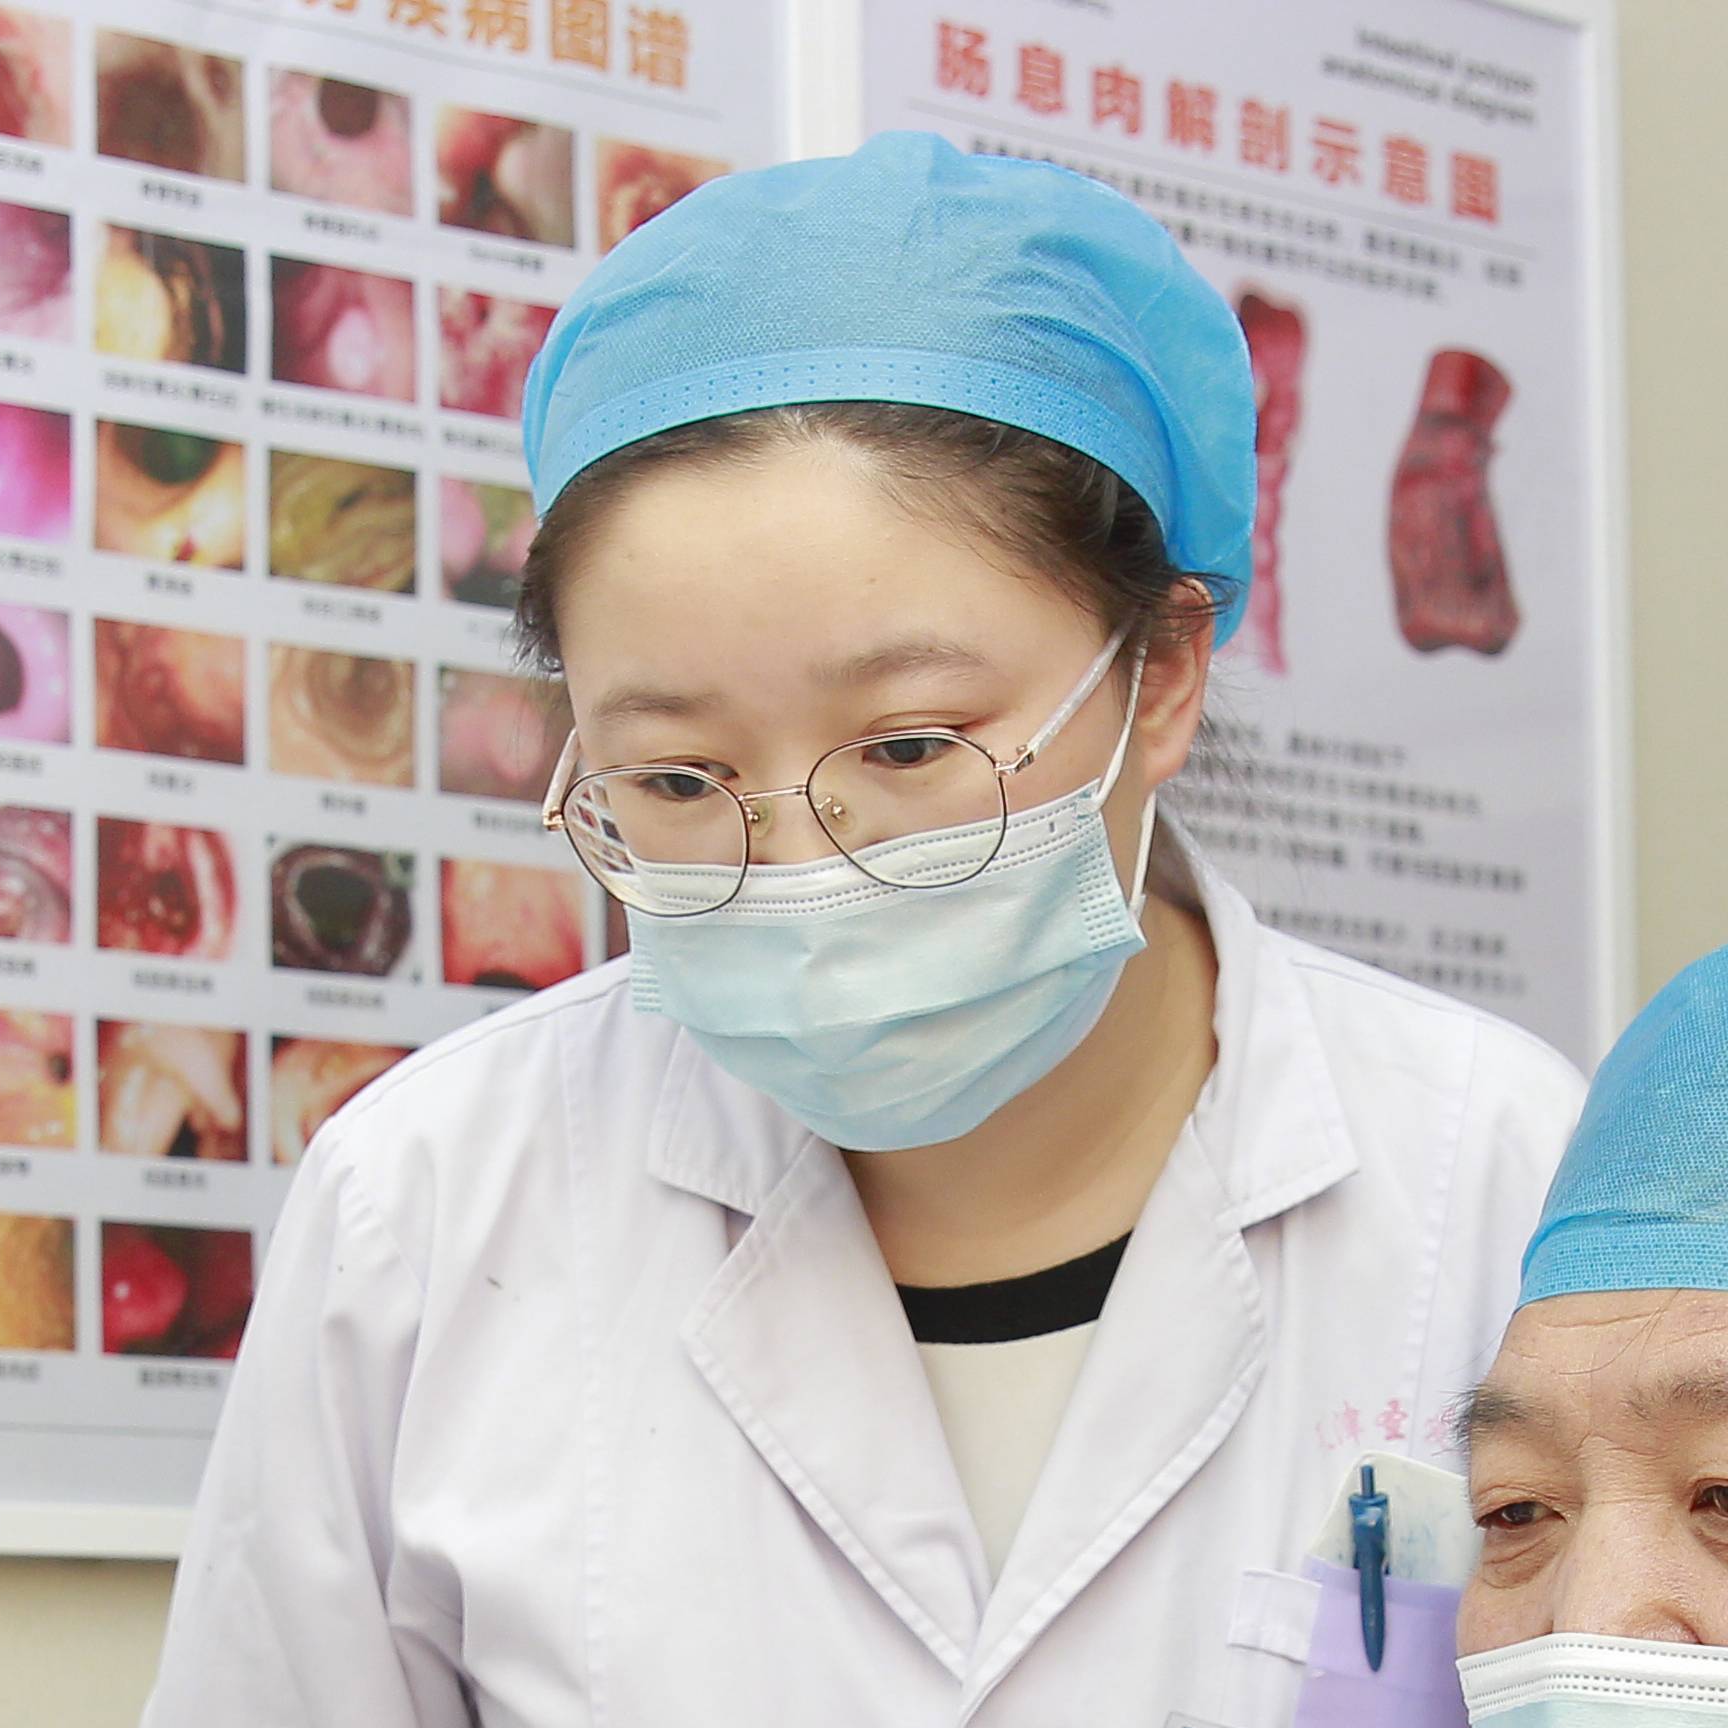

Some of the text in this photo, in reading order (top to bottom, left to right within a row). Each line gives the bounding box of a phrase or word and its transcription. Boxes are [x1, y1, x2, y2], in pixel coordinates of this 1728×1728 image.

[290, 0, 691, 91] 疾病图谱
[935, 18, 1501, 226] 肠息肉解剖示意图
